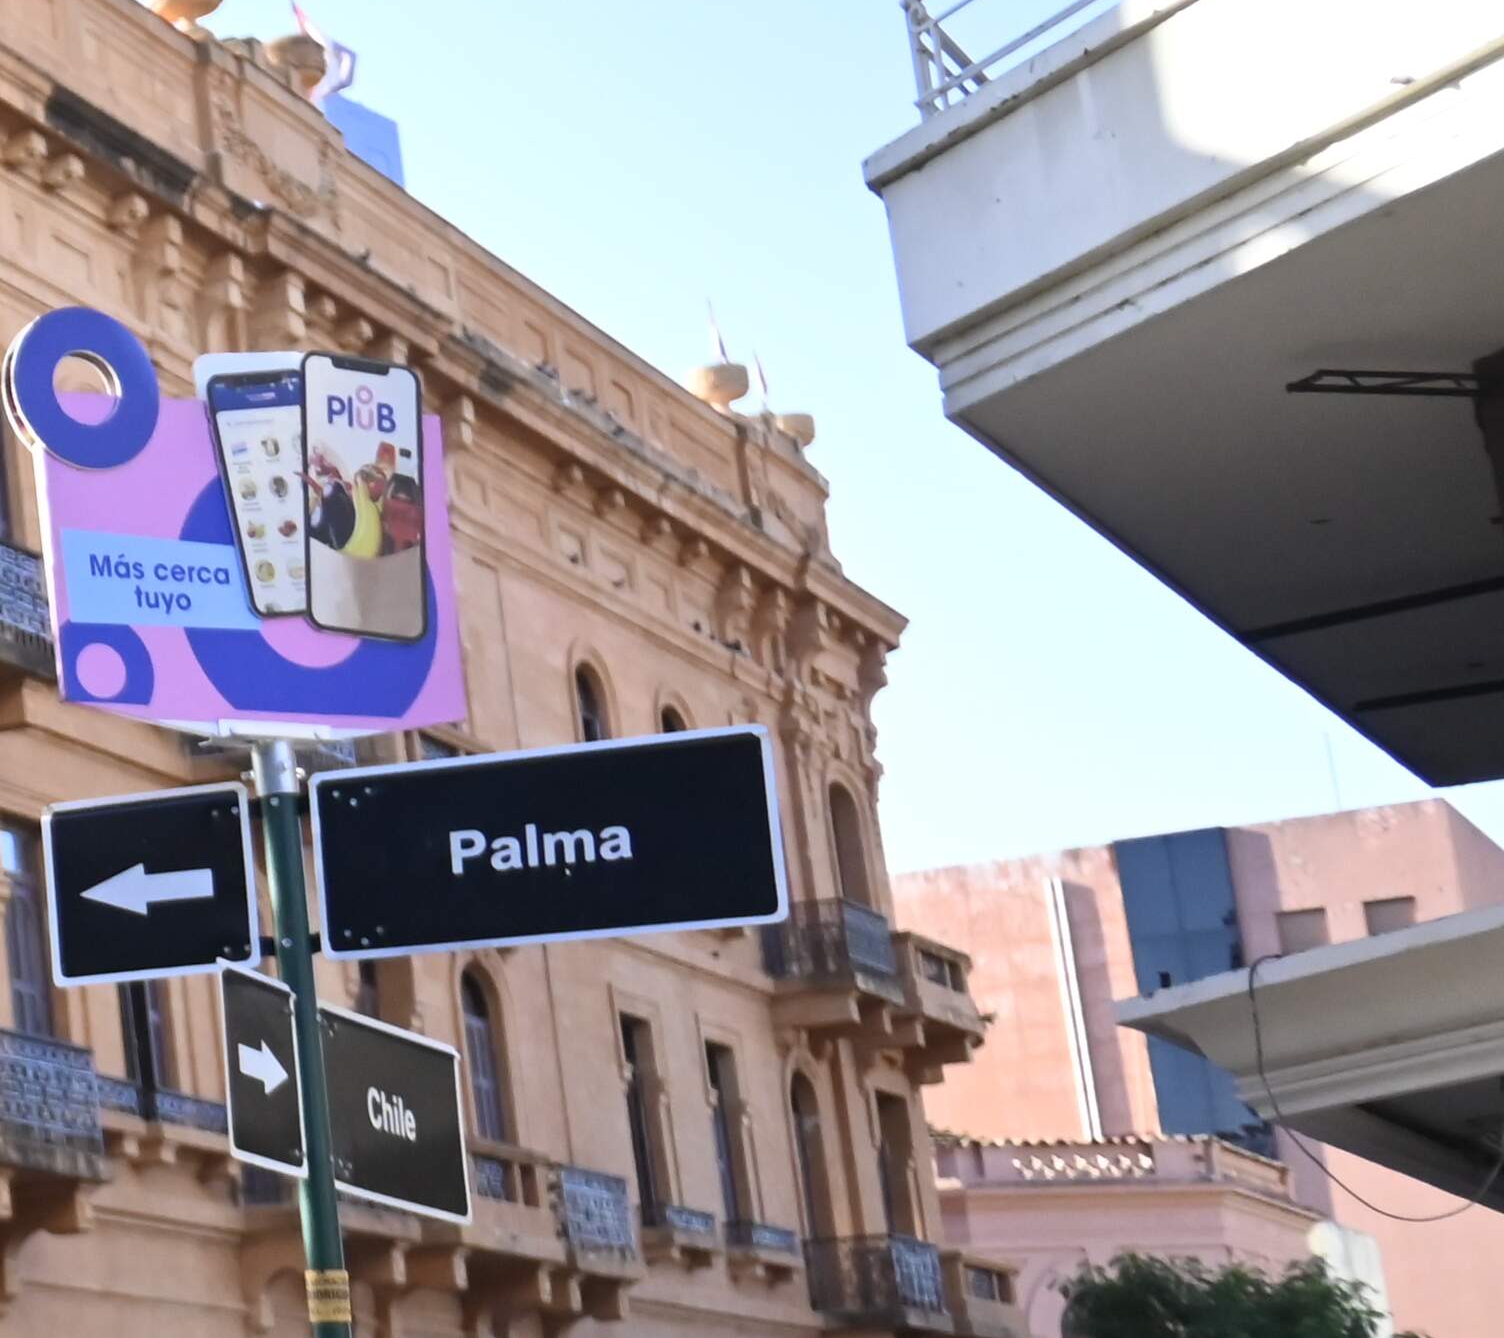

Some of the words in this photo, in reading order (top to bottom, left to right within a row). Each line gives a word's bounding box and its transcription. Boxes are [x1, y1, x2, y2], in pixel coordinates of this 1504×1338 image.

[89, 553, 145, 580] Más
[153, 562, 230, 585] cerca
[135, 585, 192, 615] tuyo
[448, 823, 633, 875] Palma
[367, 1086, 417, 1142] Chile
